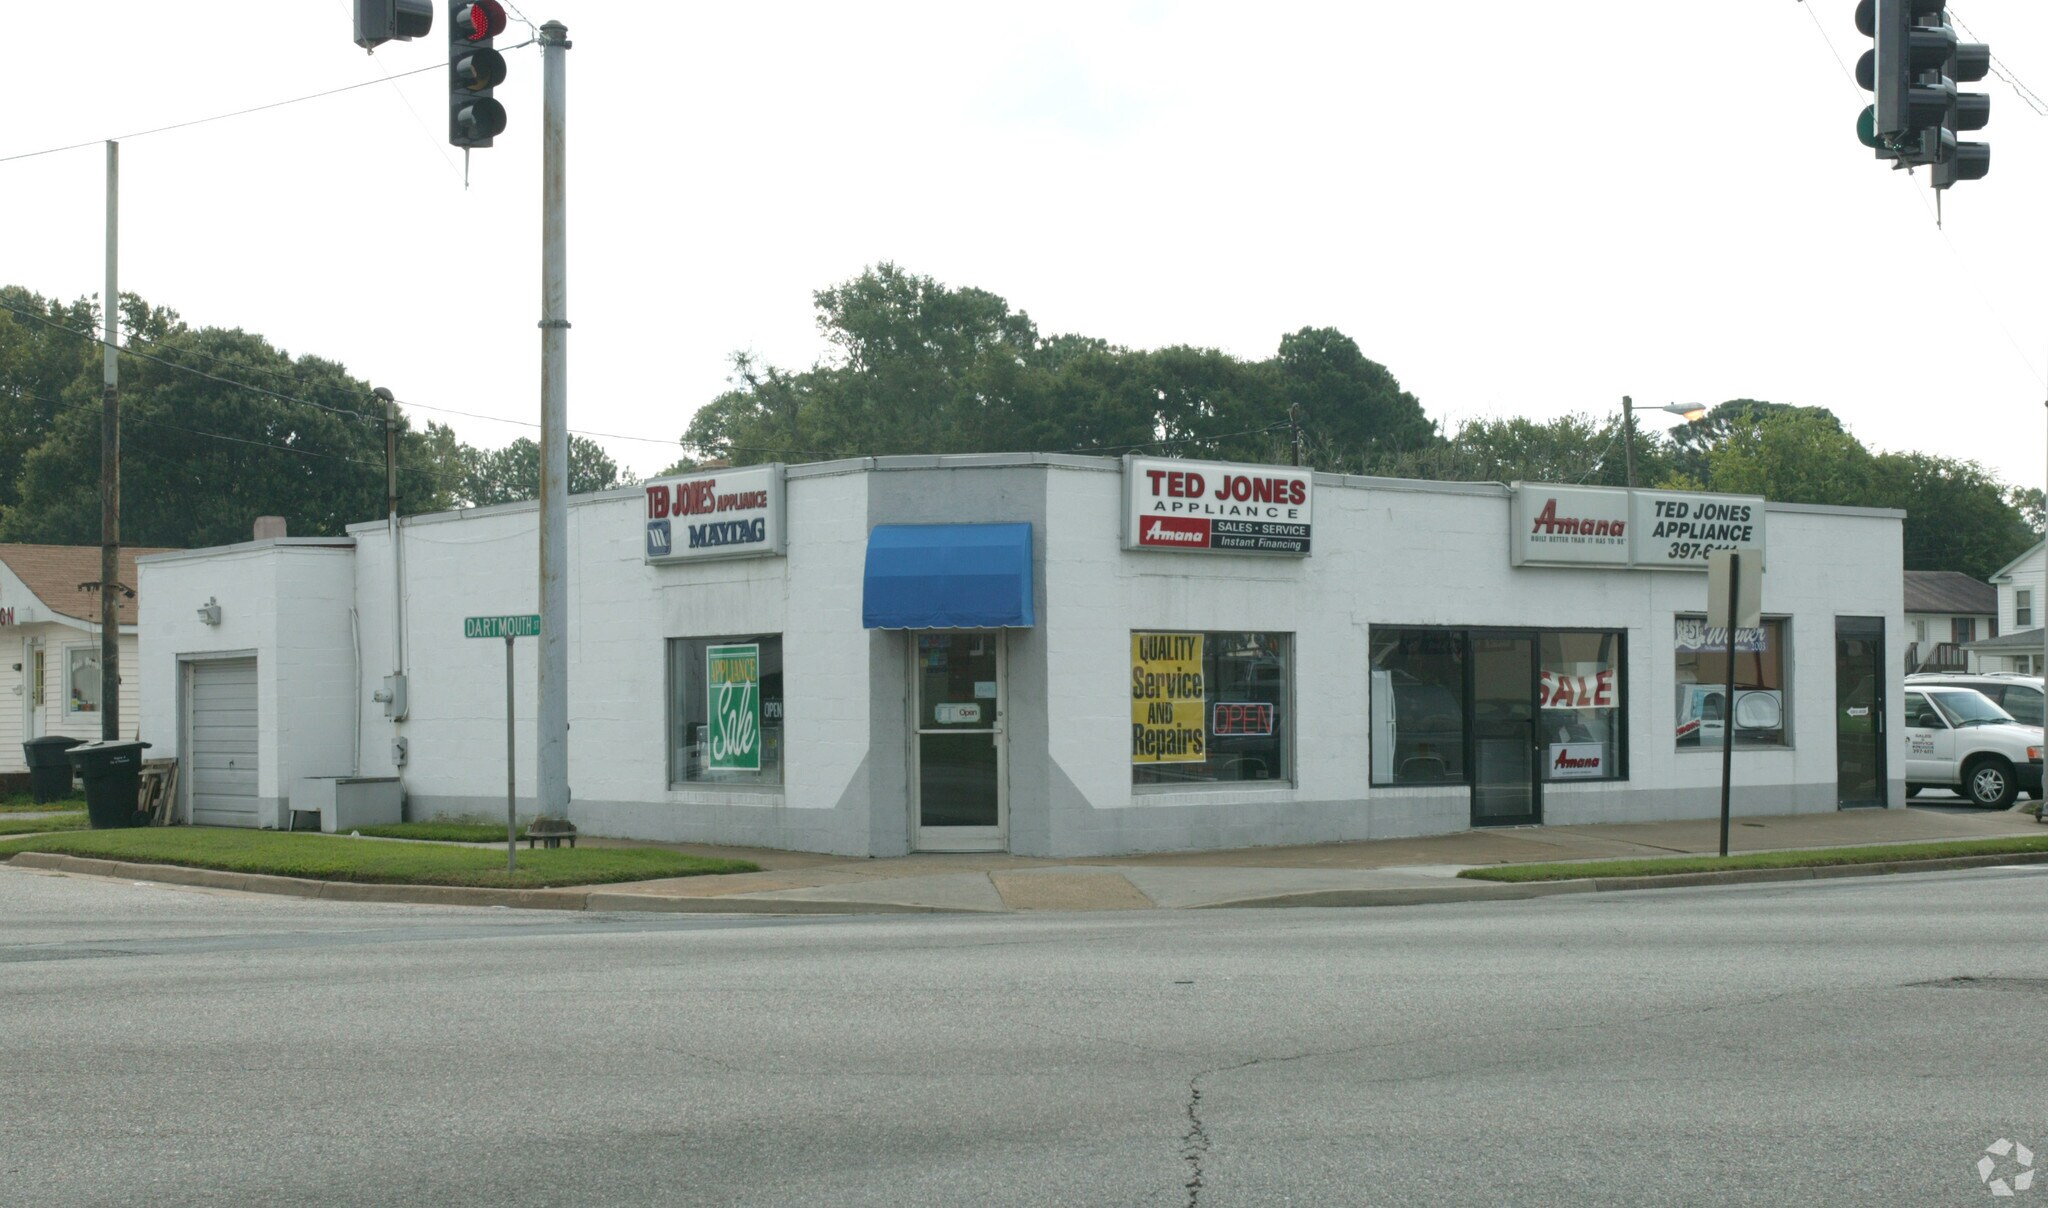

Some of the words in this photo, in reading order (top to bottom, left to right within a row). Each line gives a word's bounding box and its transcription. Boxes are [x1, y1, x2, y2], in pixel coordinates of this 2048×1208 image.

[1146, 470, 1206, 498] TED
[1215, 475, 1307, 505] JONES
[646, 486, 670, 519] TED
[672, 479, 716, 517] JONES
[717, 490, 767, 512] APPLIANCE
[1153, 501, 1299, 519] APPLIANCE
[1531, 498, 1626, 537] Amana
[1655, 500, 1689, 519] TED
[1693, 503, 1751, 522] JONES
[688, 517, 765, 549] MAYTAG
[1145, 520, 1204, 543] Amana
[1217, 521, 1253, 533] SALES
[1261, 524, 1306, 536] SERVICE
[1549, 535, 1569, 543] BETTER
[1571, 536, 1585, 544] THAN
[1652, 521, 1753, 542] APPLIANCE
[1221, 536, 1255, 548] Instant
[1257, 538, 1302, 551] Financing
[1668, 541, 1738, 560] 397-6
[467, 616, 532, 637] DARTMOUTH
[1707, 627, 1766, 644] Wnner
[1139, 636, 1196, 664] QUALITY
[711, 657, 756, 683] APPLIANCE
[1132, 666, 1202, 699] Service
[713, 679, 756, 761] Sale
[764, 702, 782, 718] OPEN
[959, 708, 977, 717] Open
[1147, 702, 1173, 725] AND
[1215, 703, 1272, 734] OPEN
[1132, 723, 1203, 760] Repairs
[1553, 748, 1600, 770] Amana
